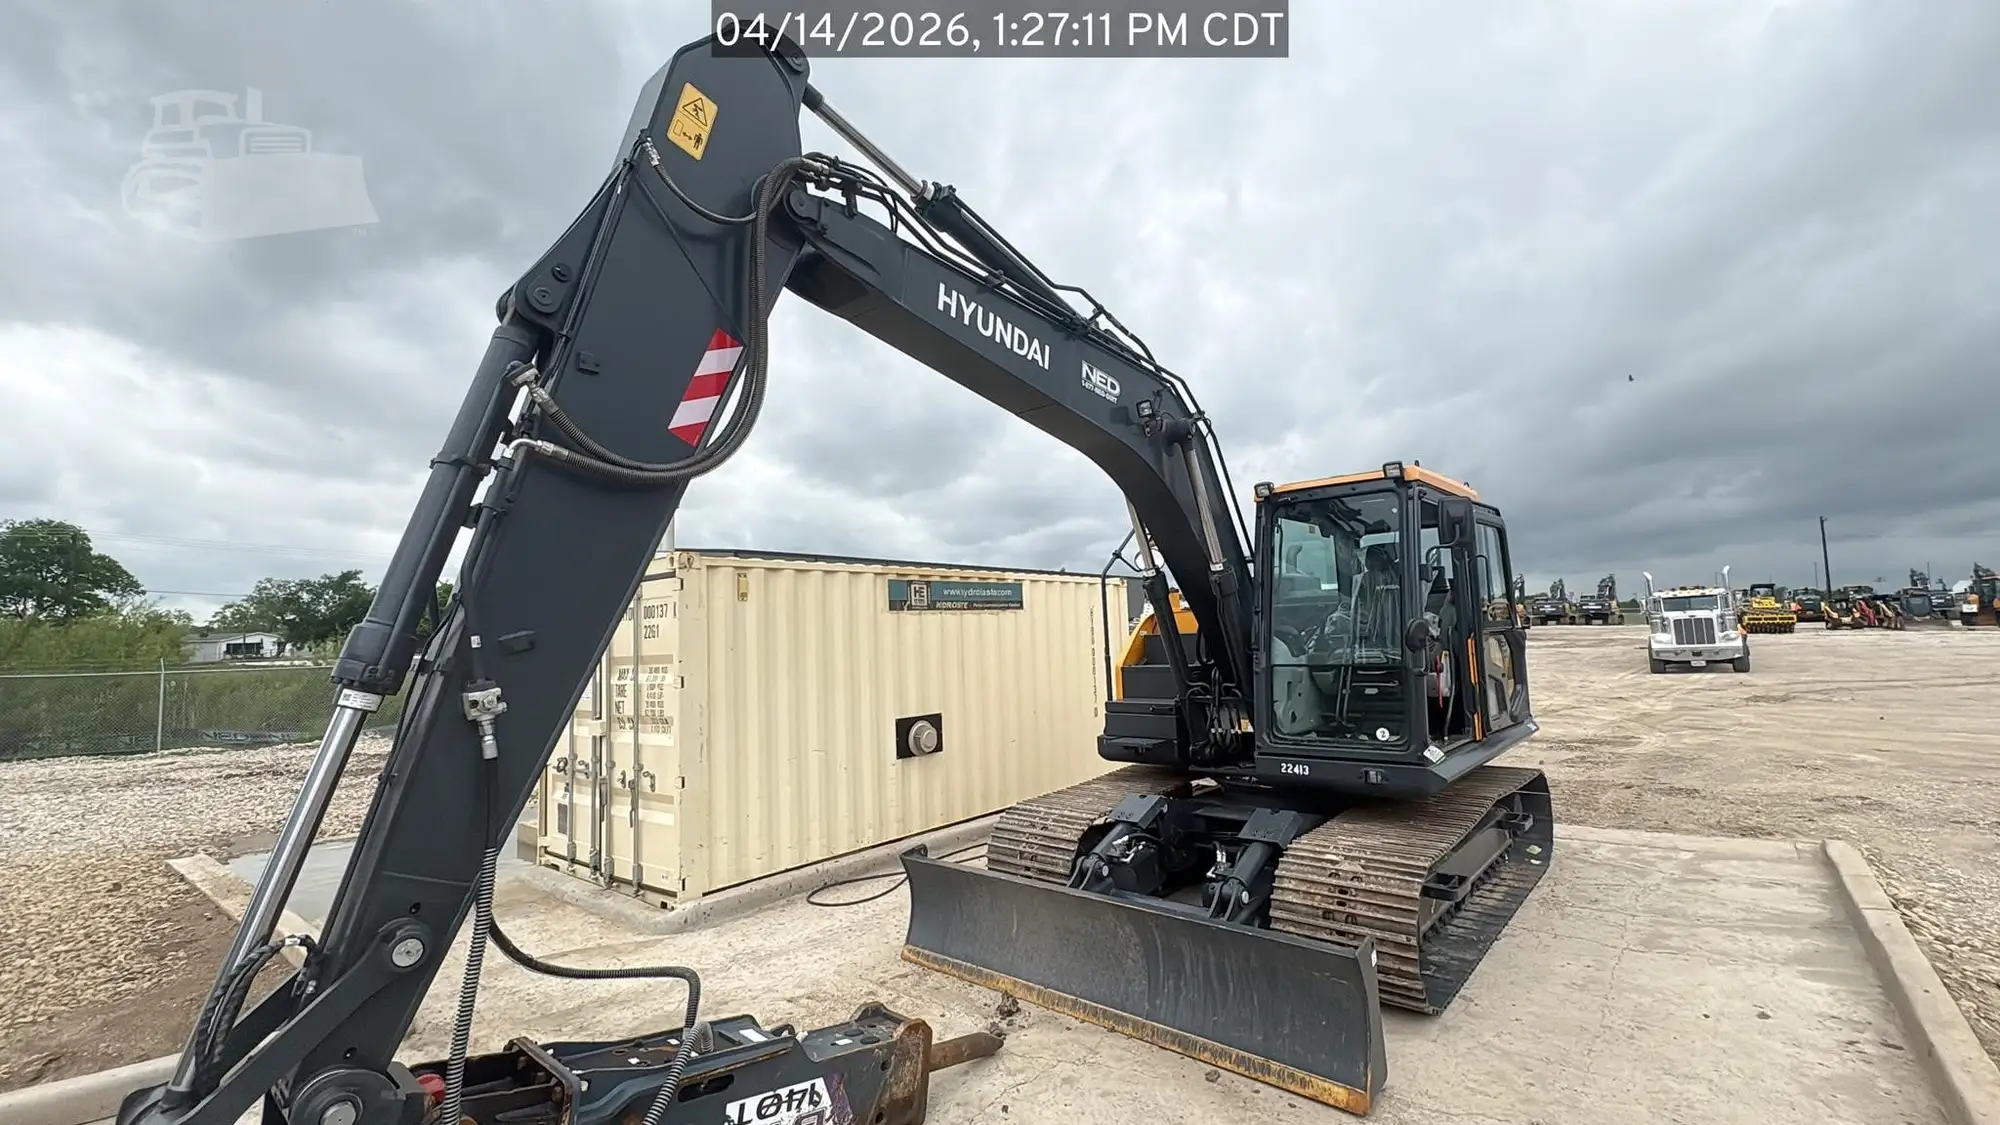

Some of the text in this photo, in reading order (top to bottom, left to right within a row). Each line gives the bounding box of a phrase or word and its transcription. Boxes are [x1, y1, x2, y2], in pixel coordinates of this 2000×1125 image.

[938, 282, 1050, 370] HYUNDAI
[1082, 360, 1120, 396] NED
[1280, 762, 1310, 776] 22413
